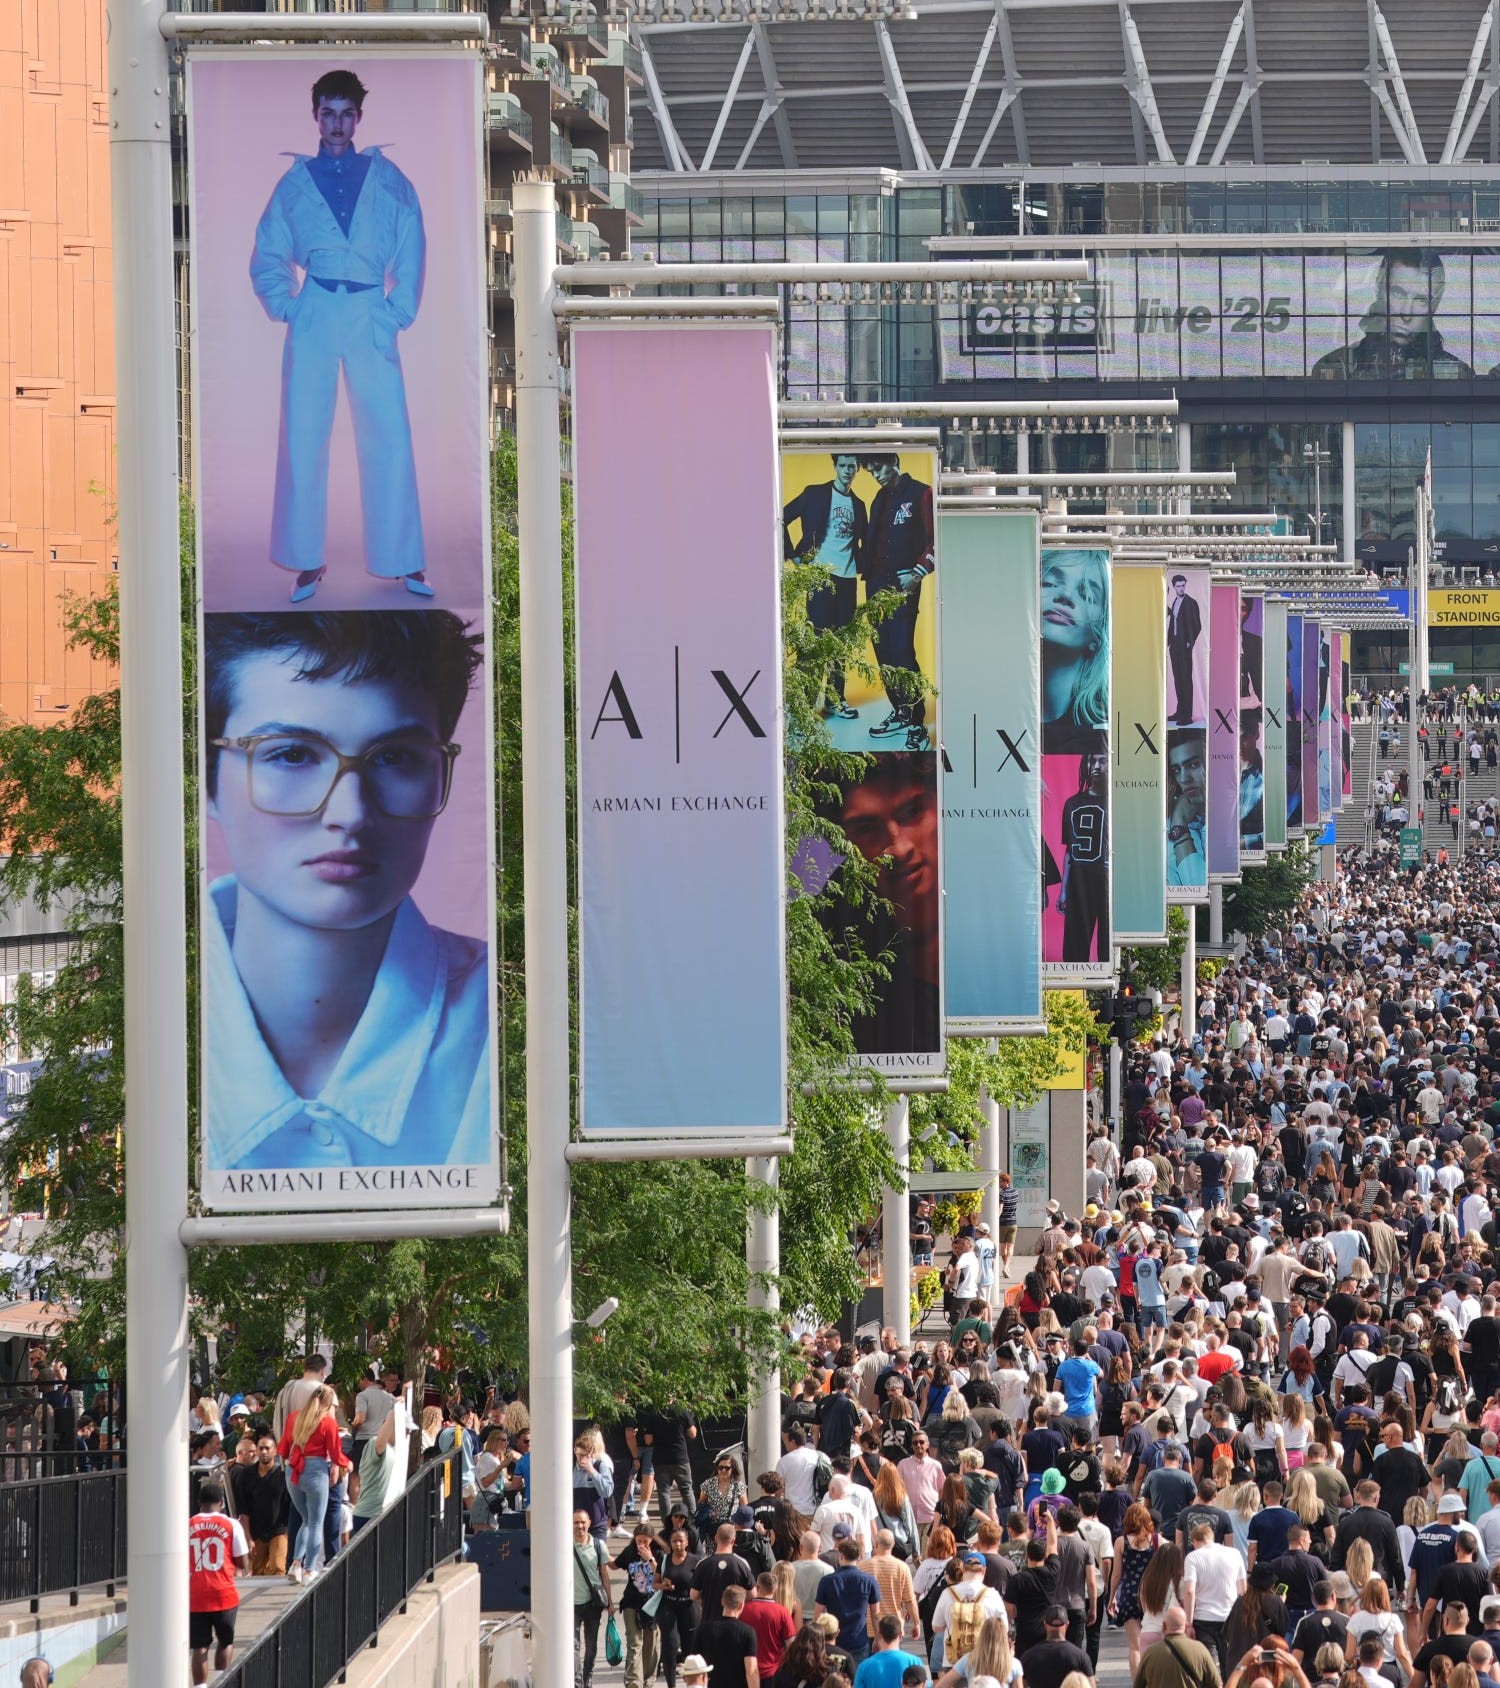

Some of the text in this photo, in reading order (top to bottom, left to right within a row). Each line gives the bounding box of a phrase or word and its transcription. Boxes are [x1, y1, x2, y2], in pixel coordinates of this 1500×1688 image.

[975, 305, 1096, 334] oasis
[1133, 297, 1212, 333] live
[1447, 594, 1488, 604] FRONT
[1436, 611, 1500, 622] STANDING
[1215, 708, 1234, 734] X
[1266, 708, 1282, 728] X
[1115, 780, 1158, 788] EXCHANGE
[592, 796, 769, 812] ARMANI EXCHANGE
[970, 808, 1032, 818] EXCHANGE
[1070, 804, 1105, 862] 9
[1053, 963, 1104, 971] EXCHANGE
[1315, 1040, 1329, 1049] 25
[859, 1055, 934, 1067] EXCHANGE
[222, 1167, 478, 1192] ARMANI EXCHANGE
[882, 1430, 905, 1447] 25
[190, 1536, 224, 1571] 10
